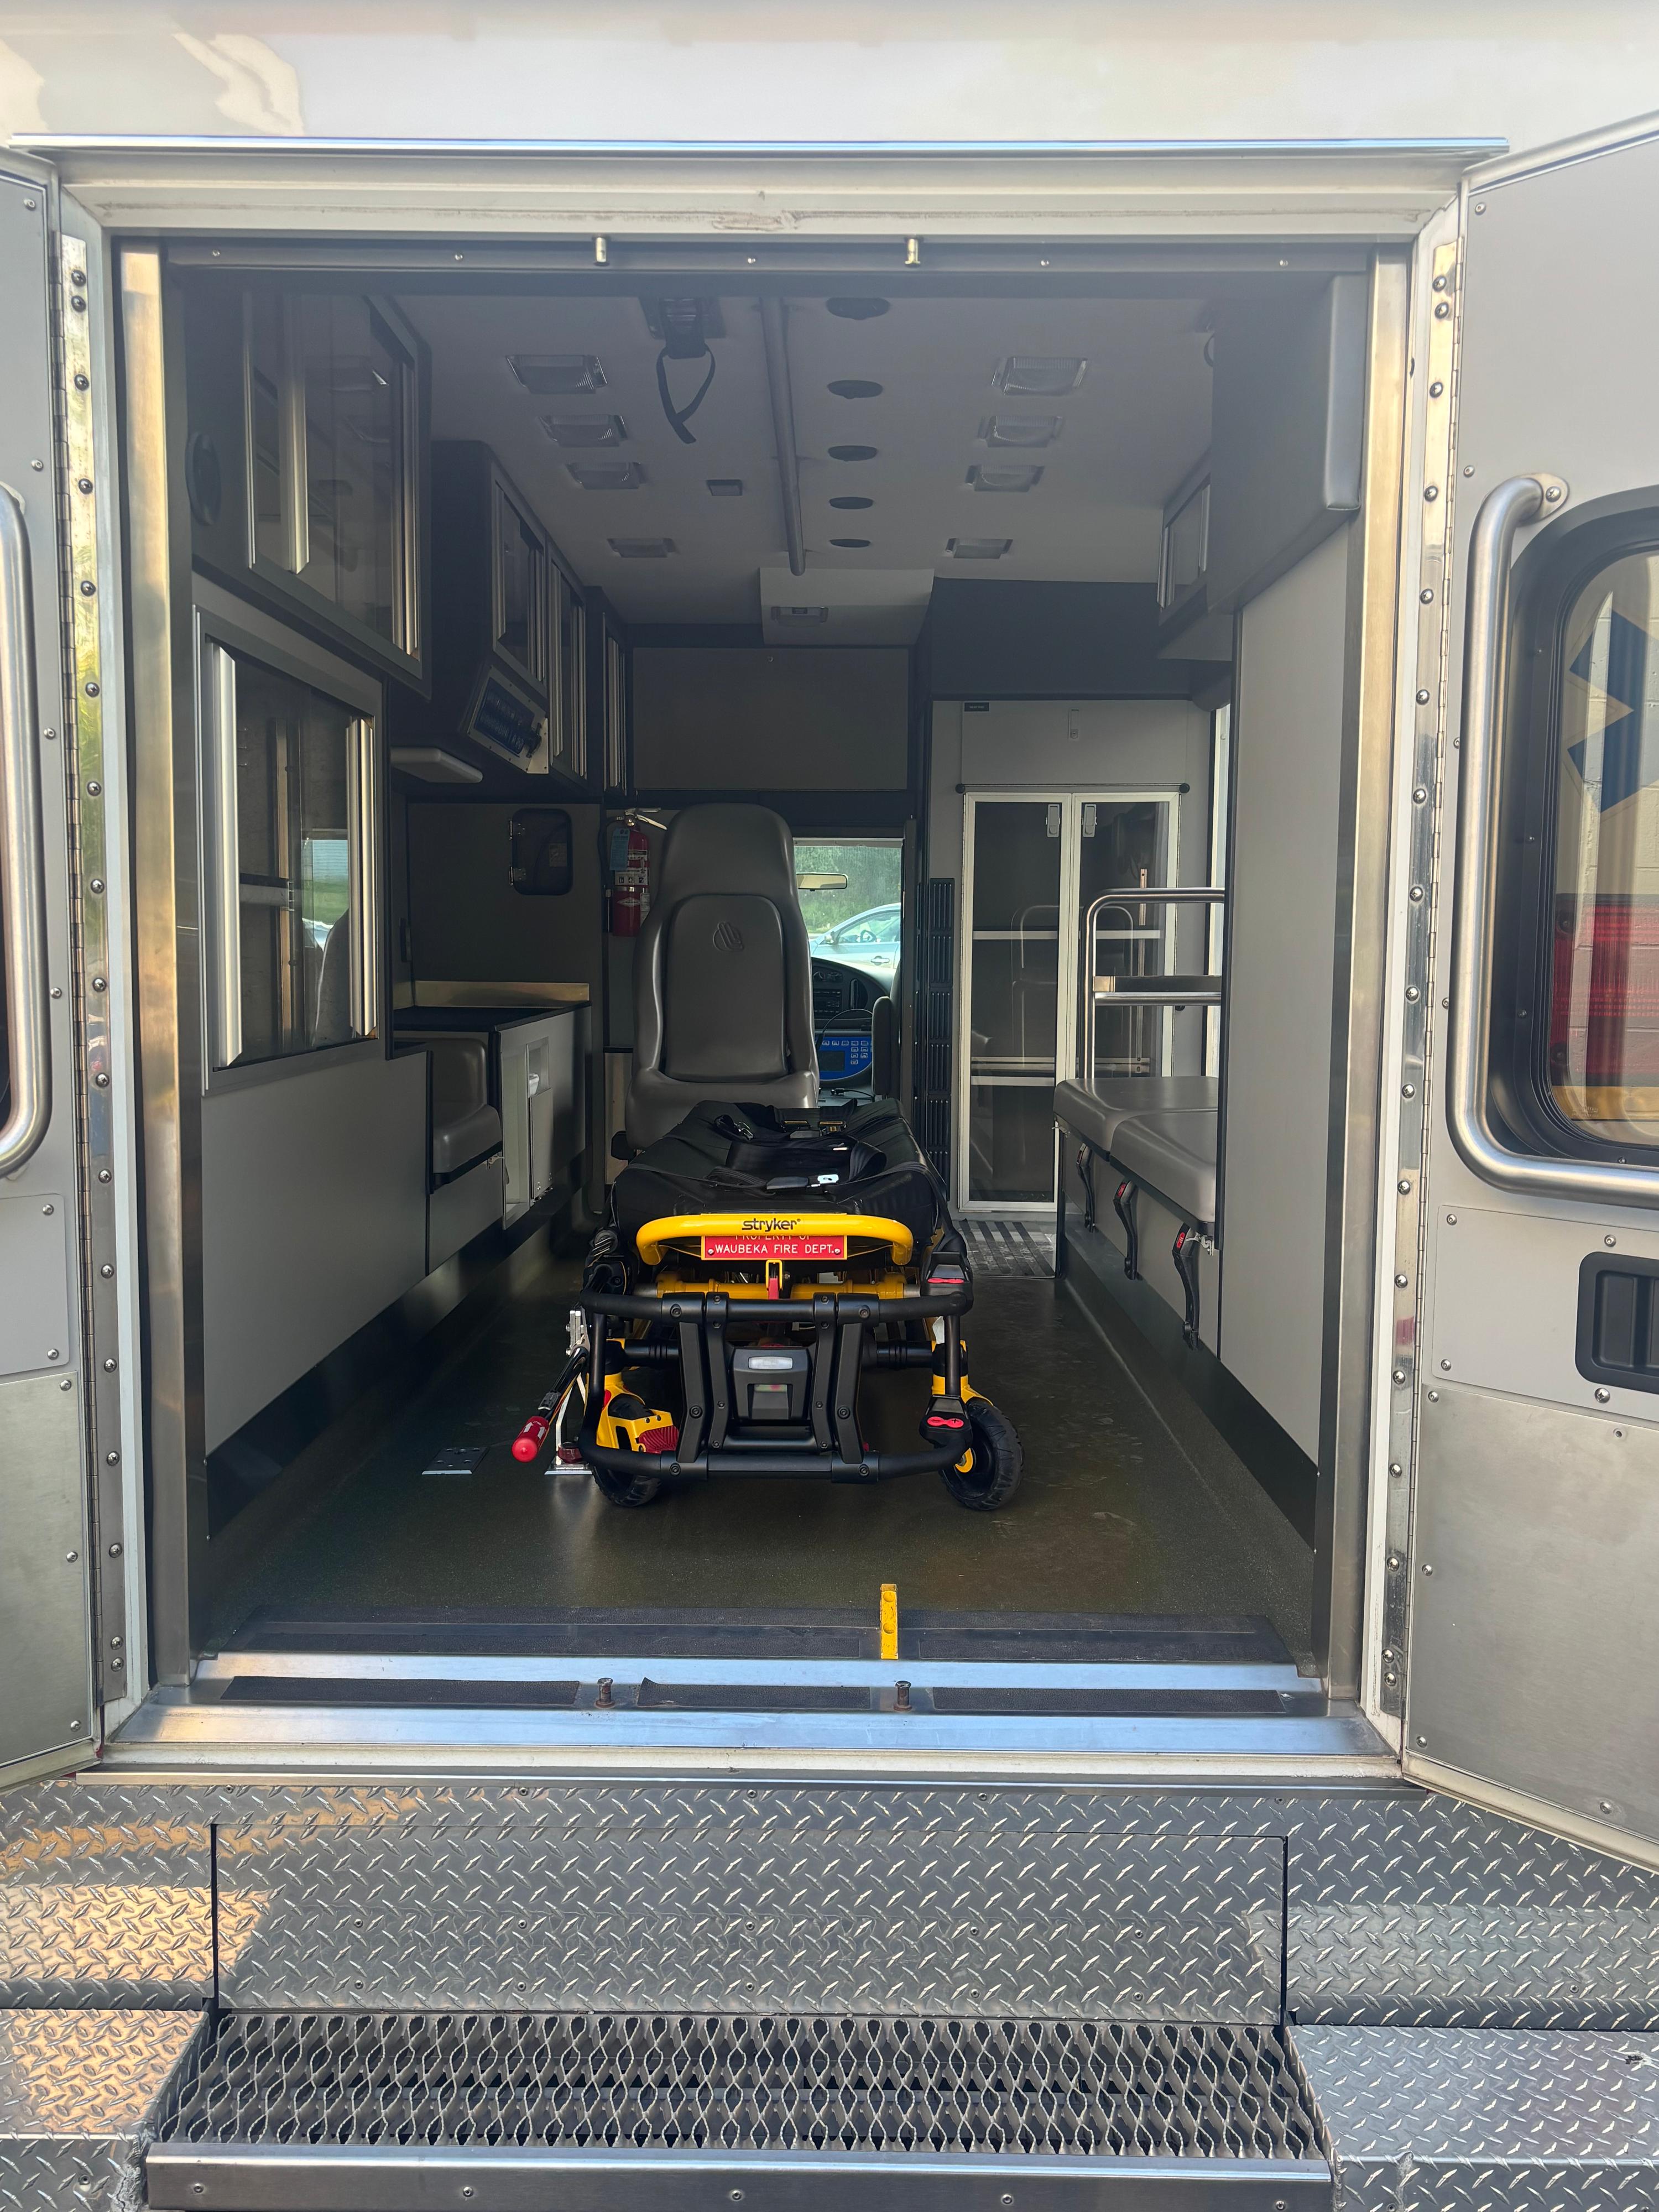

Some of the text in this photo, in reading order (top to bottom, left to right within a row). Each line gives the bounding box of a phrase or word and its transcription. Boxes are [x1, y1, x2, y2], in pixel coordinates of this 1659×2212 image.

[742, 1218, 797, 1232] stryker
[715, 1244, 834, 1254] WAUBEKA FIRE DEPT.
